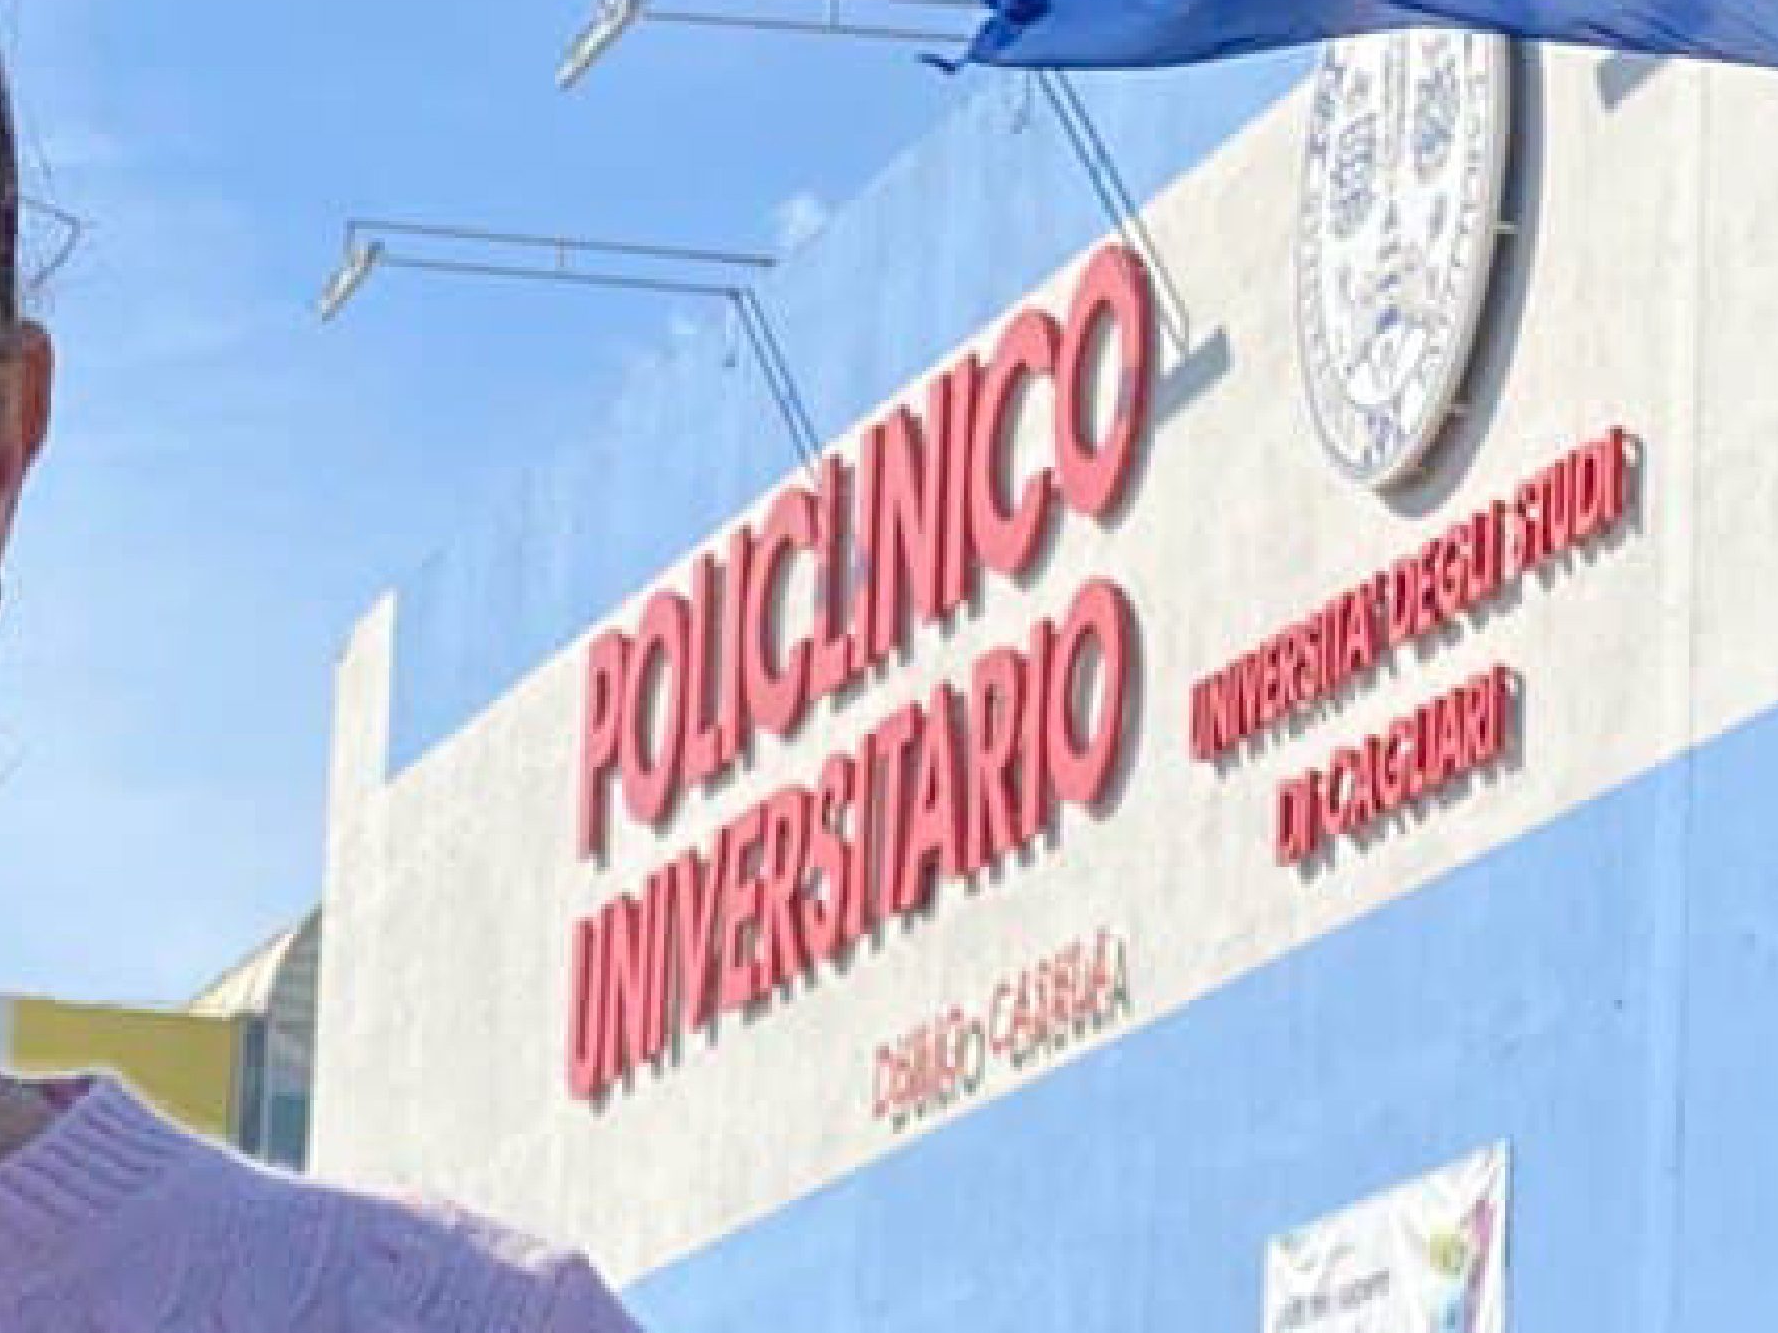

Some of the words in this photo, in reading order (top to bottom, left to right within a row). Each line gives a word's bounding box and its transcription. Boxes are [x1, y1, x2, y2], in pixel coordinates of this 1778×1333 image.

[580, 241, 1147, 861] POLICLINICO
[1385, 499, 1507, 648] DEGLI
[1514, 426, 1626, 574] STUDI
[569, 579, 1132, 1102] UNIVERSITARIO
[1276, 768, 1324, 868] DI
[1324, 665, 1509, 834] CAGLIARI
